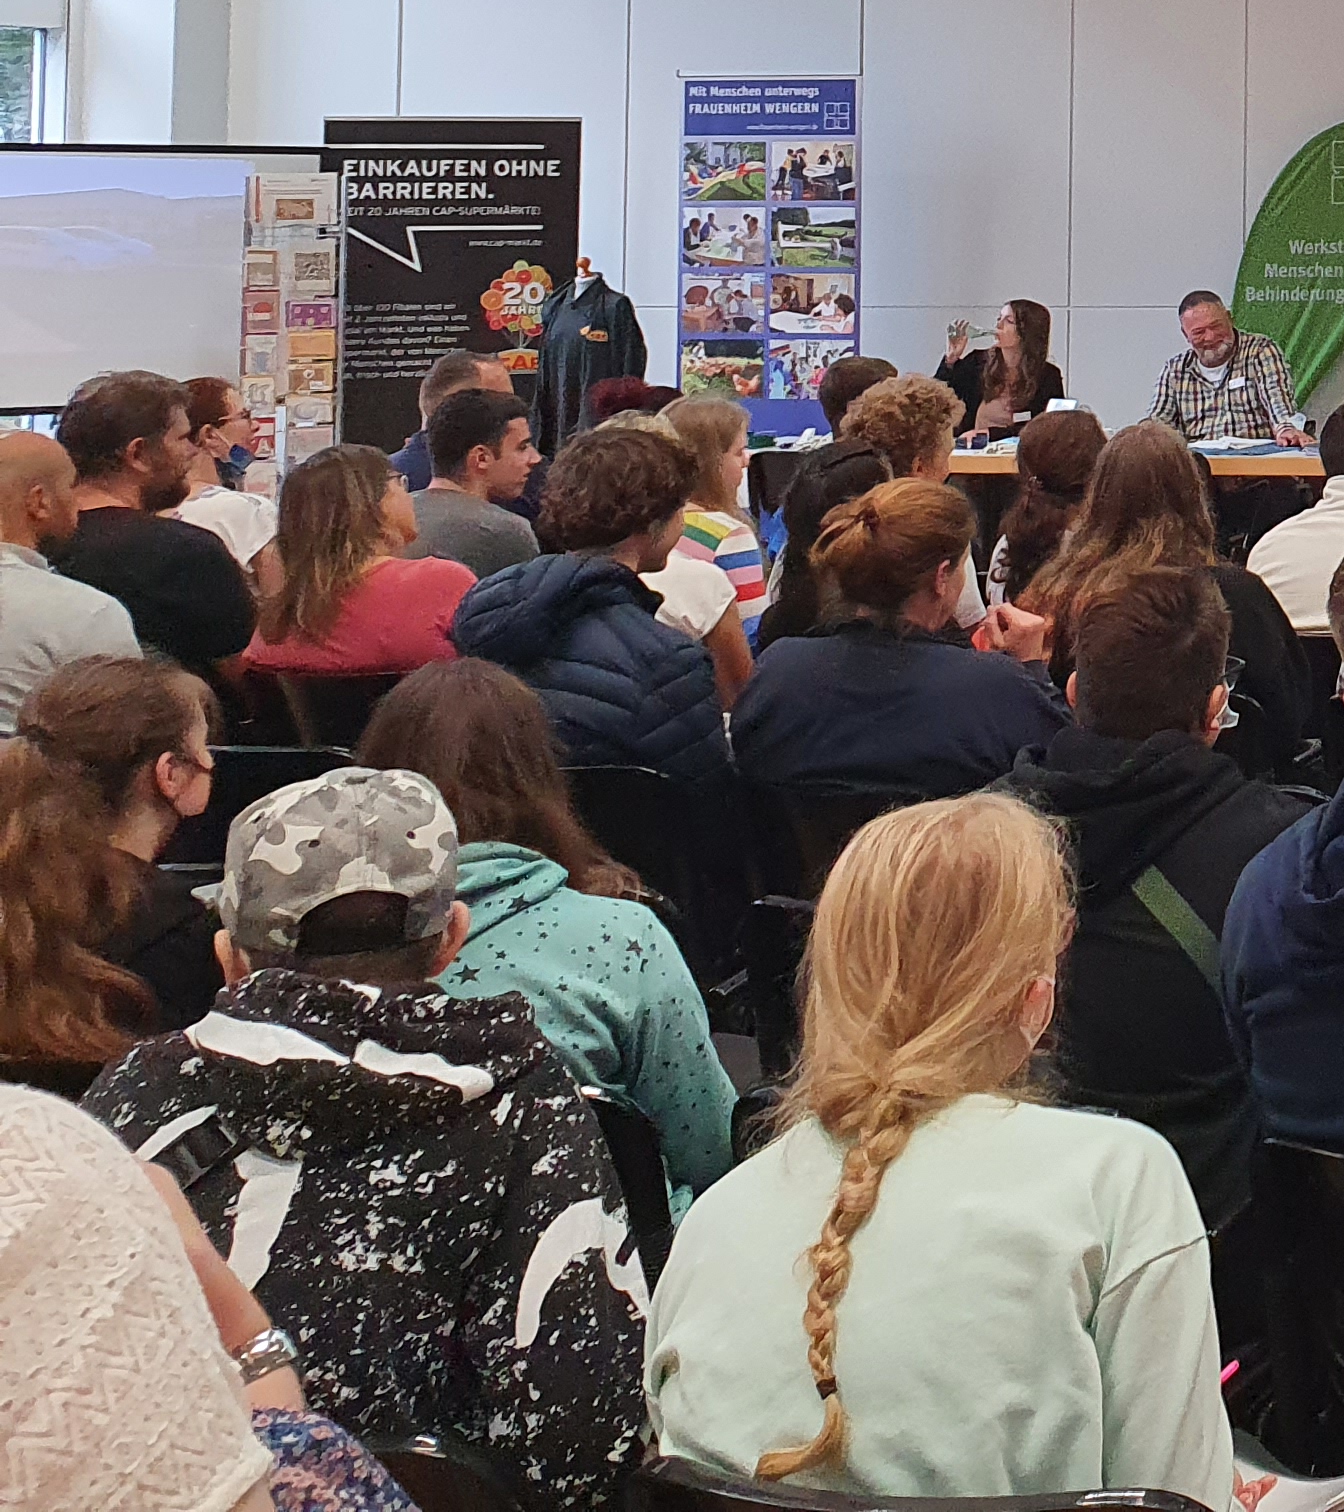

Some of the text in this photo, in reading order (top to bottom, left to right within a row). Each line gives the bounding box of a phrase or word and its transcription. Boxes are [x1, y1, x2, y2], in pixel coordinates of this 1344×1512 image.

[689, 85, 819, 99] Mit Menschen unterwegs
[689, 102, 819, 114] FRAUENHEIM WENGERN
[343, 159, 561, 177] EINKAUFEN OHNE
[347, 182, 495, 200] BARRIEREN.
[385, 207, 429, 216] JAHREN
[1264, 262, 1343, 278] Menschen
[502, 282, 545, 305] 20
